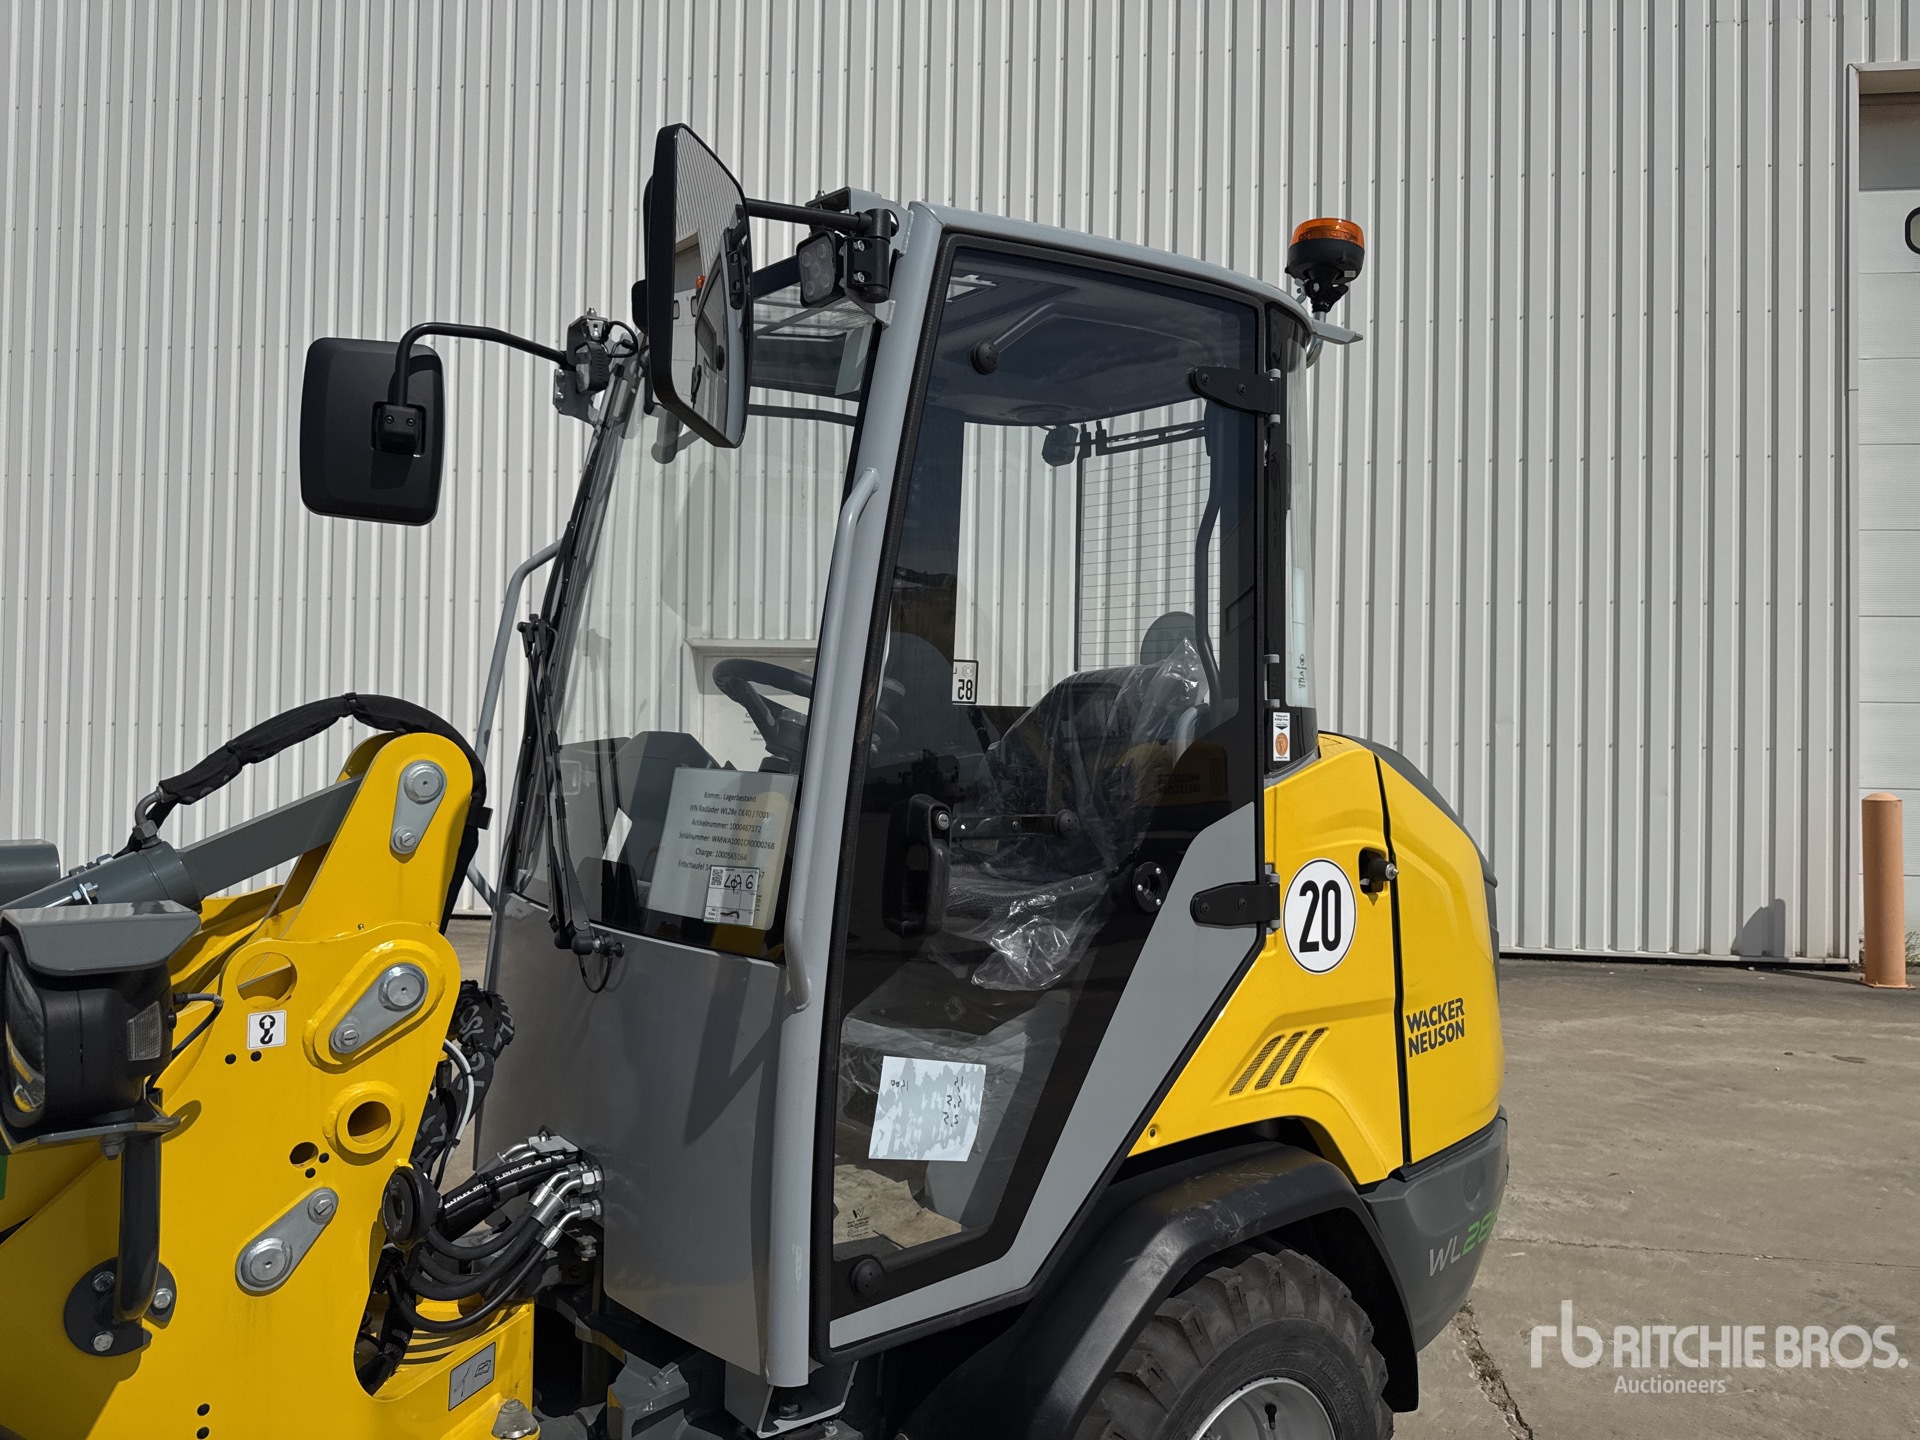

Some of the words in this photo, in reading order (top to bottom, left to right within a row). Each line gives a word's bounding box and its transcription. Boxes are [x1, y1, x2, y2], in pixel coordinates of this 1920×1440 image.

[698, 805, 720, 814] Radlader
[723, 793, 757, 802] Lagerbestand
[695, 847, 713, 858] Charge:
[1298, 879, 1342, 953] 20
[1405, 997, 1465, 1034] WACKER
[1407, 1018, 1465, 1058] NEUSON
[1429, 1206, 1499, 1277] WL28
